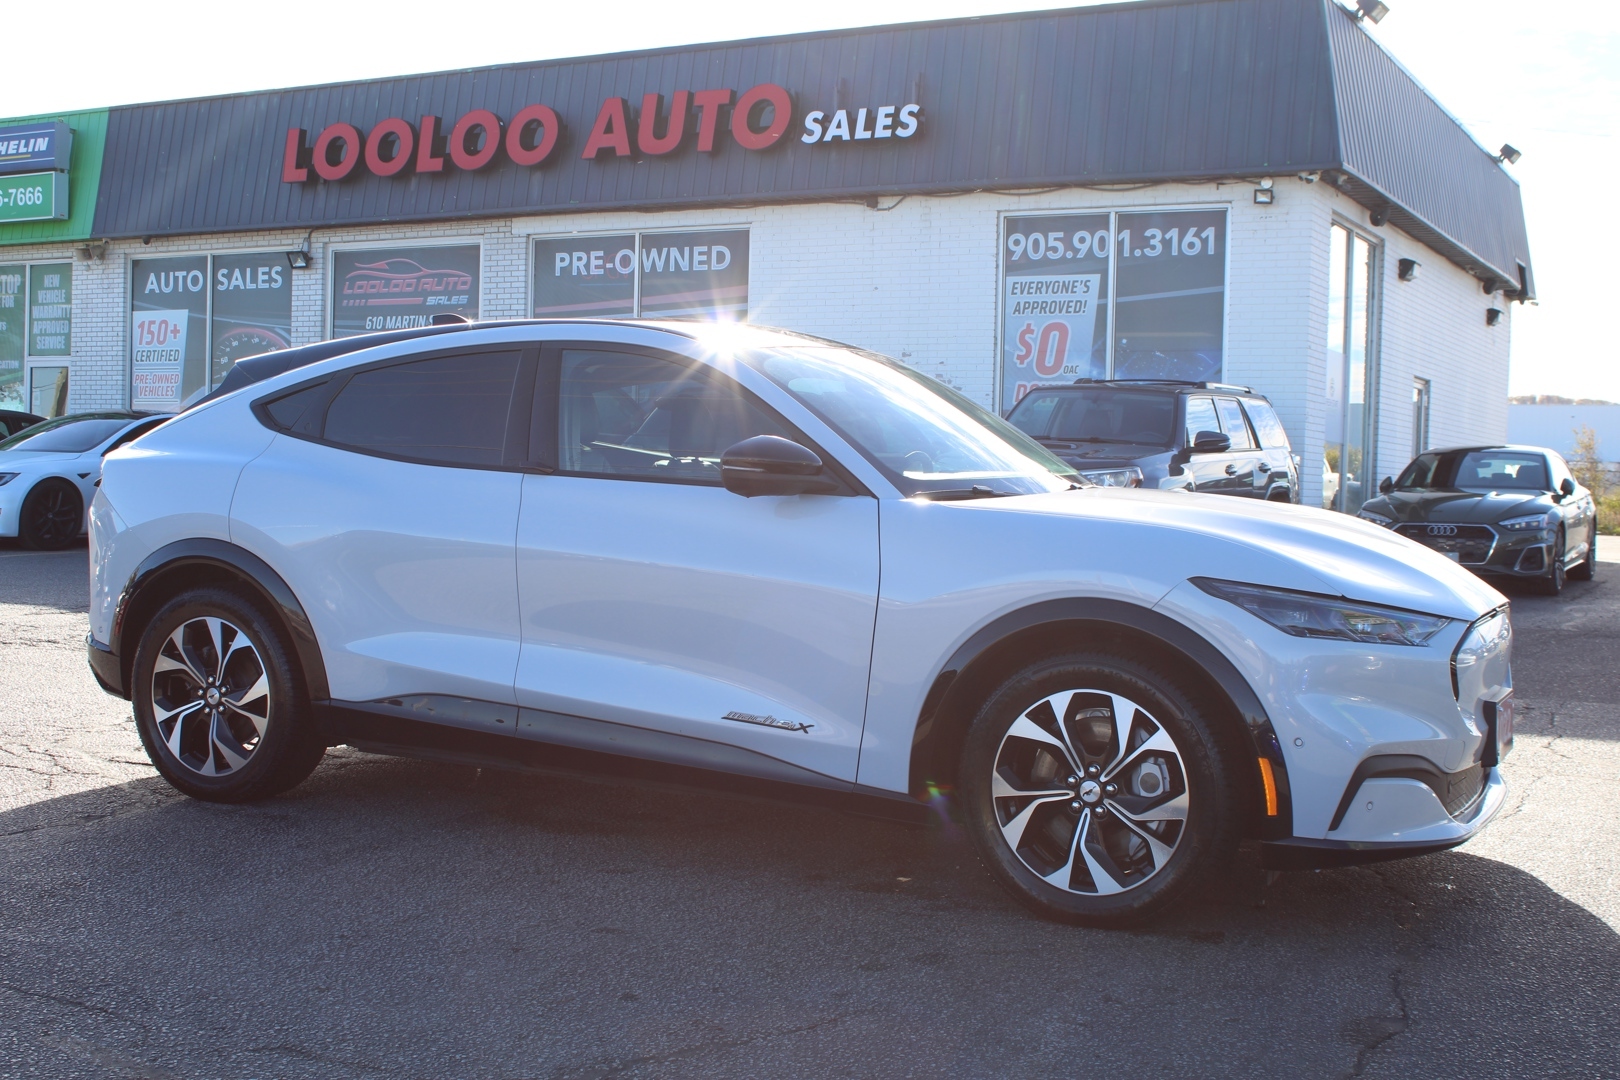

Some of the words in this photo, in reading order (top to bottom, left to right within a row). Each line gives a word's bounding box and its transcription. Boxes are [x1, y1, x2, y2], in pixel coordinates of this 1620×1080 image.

[282, 104, 559, 183] LOOLOO
[582, 83, 792, 160] AUTO
[800, 103, 920, 145] SALES
[1007, 226, 1215, 260] 905.901.3161
[555, 245, 731, 276] PRE-OWNED
[0, 274, 21, 295] TOP
[44, 274, 60, 287] NEW
[144, 270, 203, 293] AUTO
[217, 266, 282, 291] SALES
[343, 279, 417, 294] LOOLOO
[418, 276, 472, 292] AUTO
[1010, 279, 1091, 296] EVERYONE'S
[38, 289, 66, 303] VEHICLE
[425, 295, 469, 305] SALES
[32, 304, 71, 319] WARRANTY
[1012, 300, 1087, 315] APPROVED!
[33, 320, 69, 334] APPROVED
[365, 316, 383, 329] 610
[385, 315, 426, 329] MARTIN
[137, 319, 181, 346] 150+
[36, 336, 65, 349] SERVICE
[1016, 322, 1069, 376] $0
[134, 349, 180, 363] CERTIFIED
[1063, 365, 1079, 375] OAC
[134, 373, 180, 386] PRE-OWNED
[138, 384, 175, 397] VEHICLES
